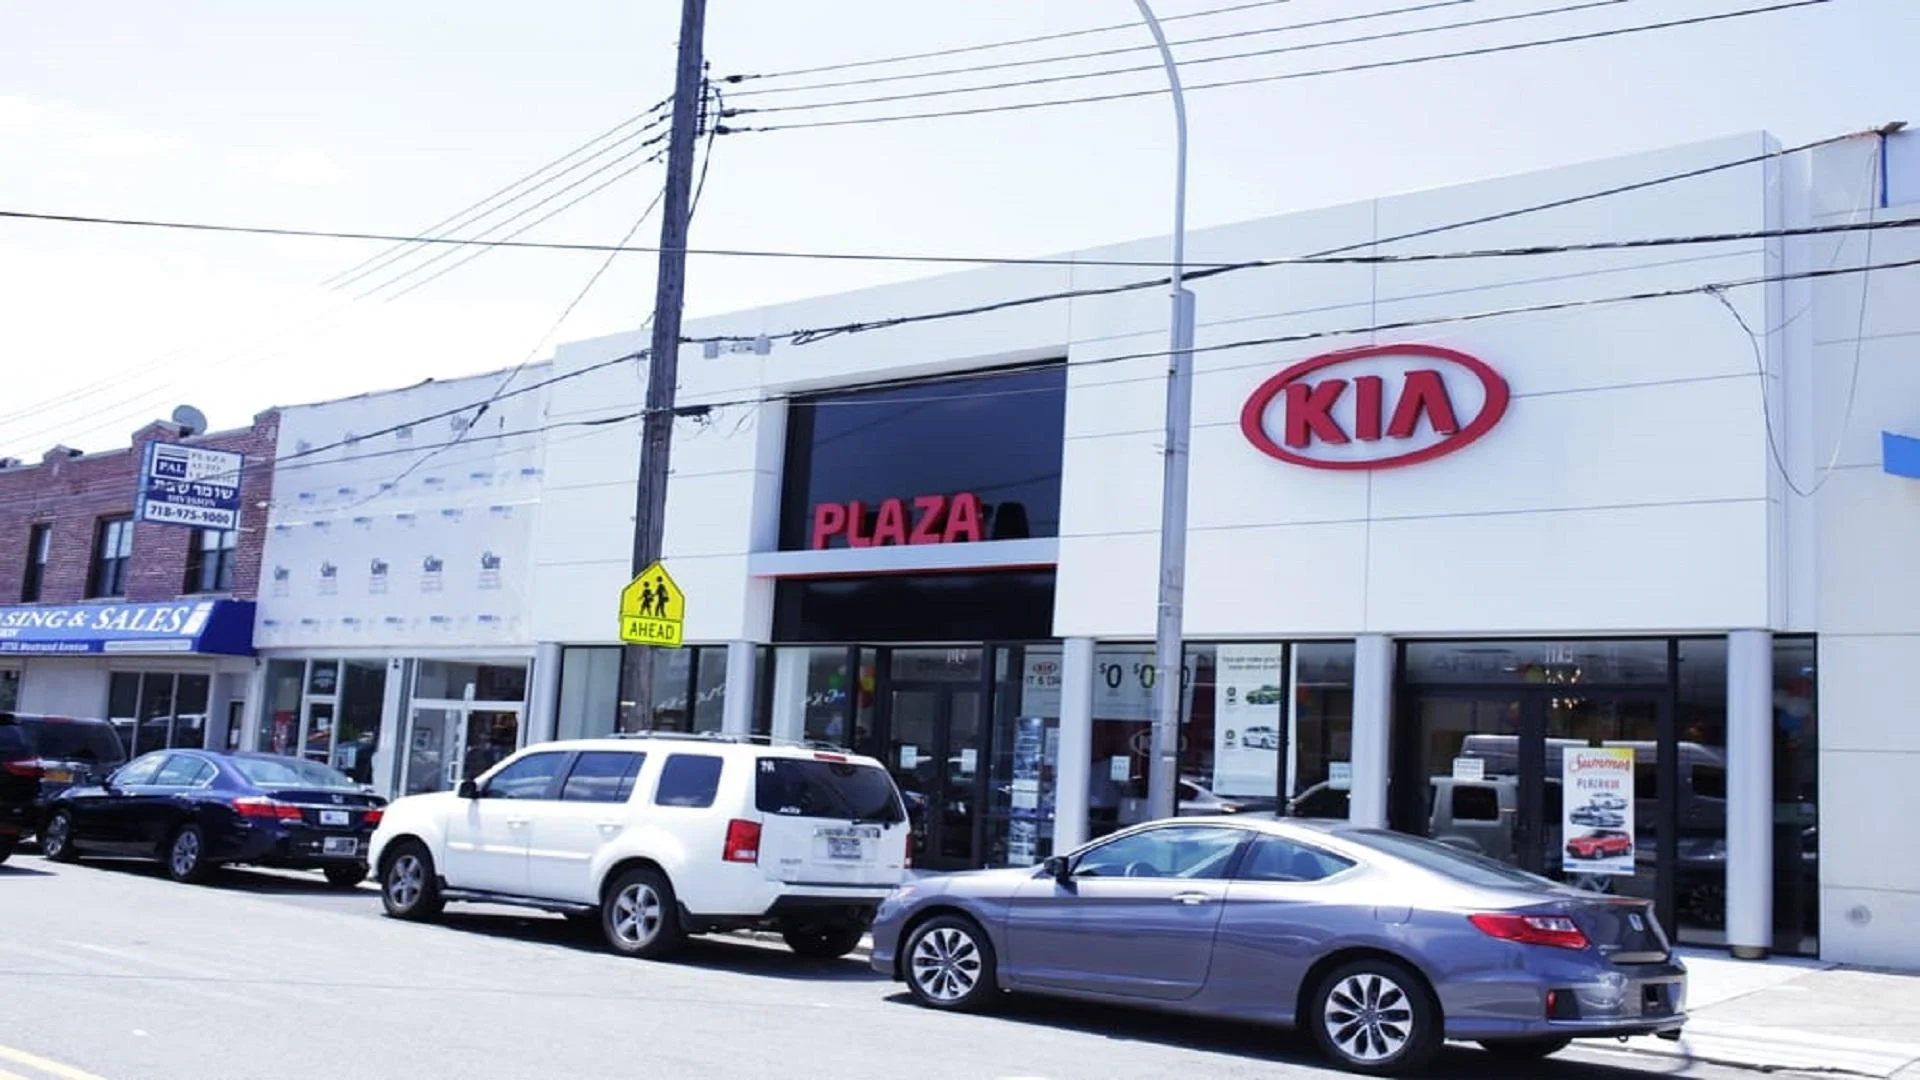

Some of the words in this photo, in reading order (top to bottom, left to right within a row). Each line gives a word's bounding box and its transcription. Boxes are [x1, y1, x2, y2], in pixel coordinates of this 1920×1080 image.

[1285, 369, 1461, 448] KIA
[812, 491, 985, 551] PLAZA
[0, 610, 68, 629] SING
[91, 607, 190, 633] SALES
[629, 621, 675, 640] AHEAD
